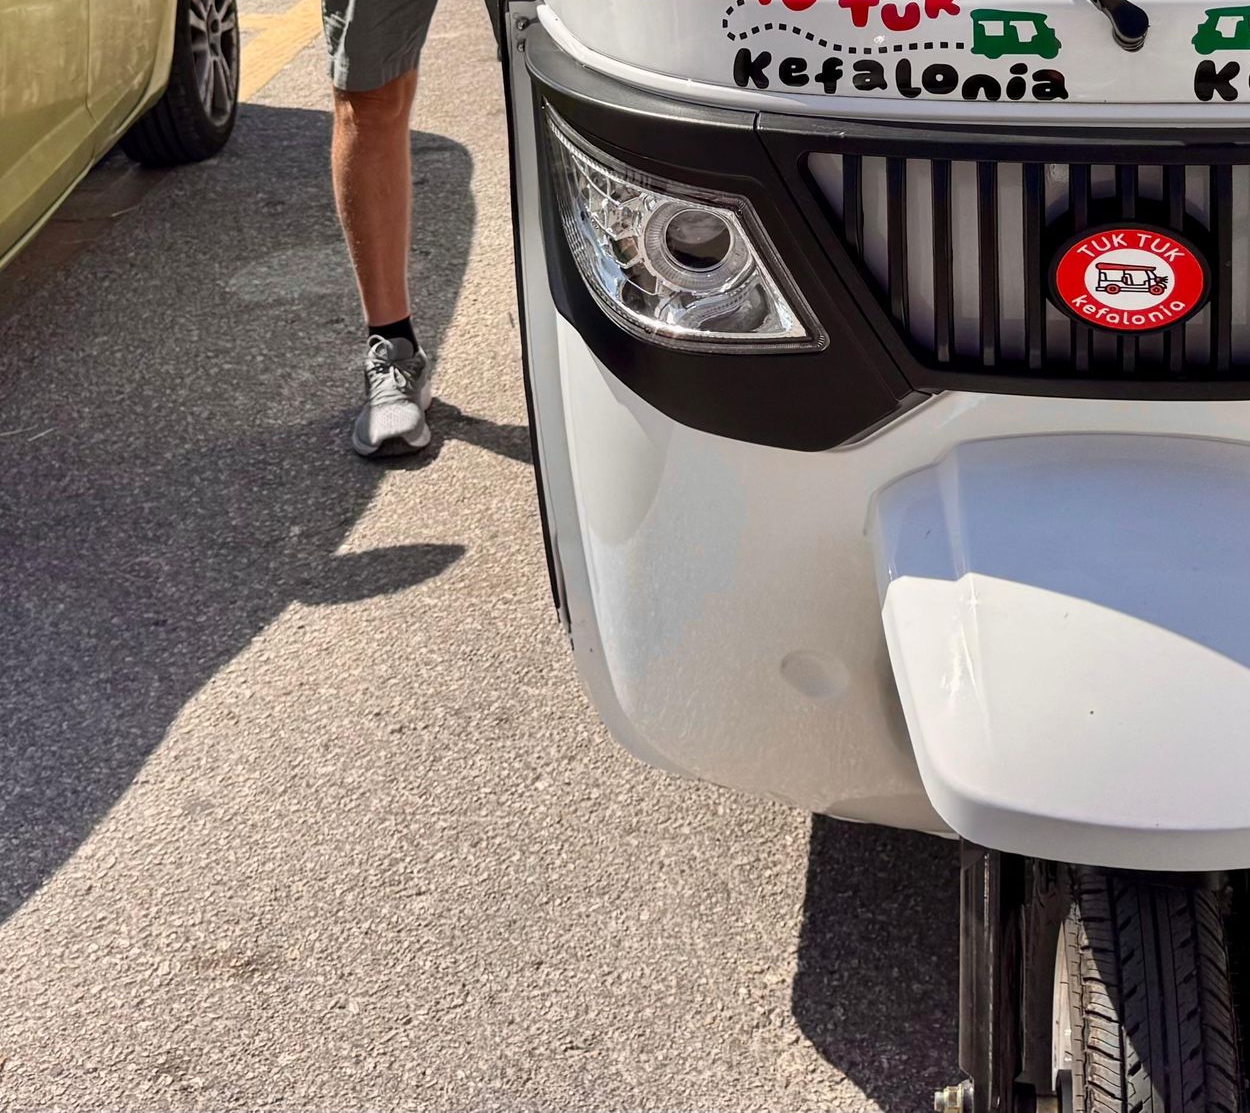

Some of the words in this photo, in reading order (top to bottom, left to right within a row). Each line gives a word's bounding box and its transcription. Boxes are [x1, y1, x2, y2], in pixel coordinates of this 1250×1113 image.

[733, 47, 1070, 102] Kefalonia
[1077, 233, 1128, 259] TUK
[1136, 233, 1186, 262] TUK
[1071, 294, 1186, 326] kefalonia
